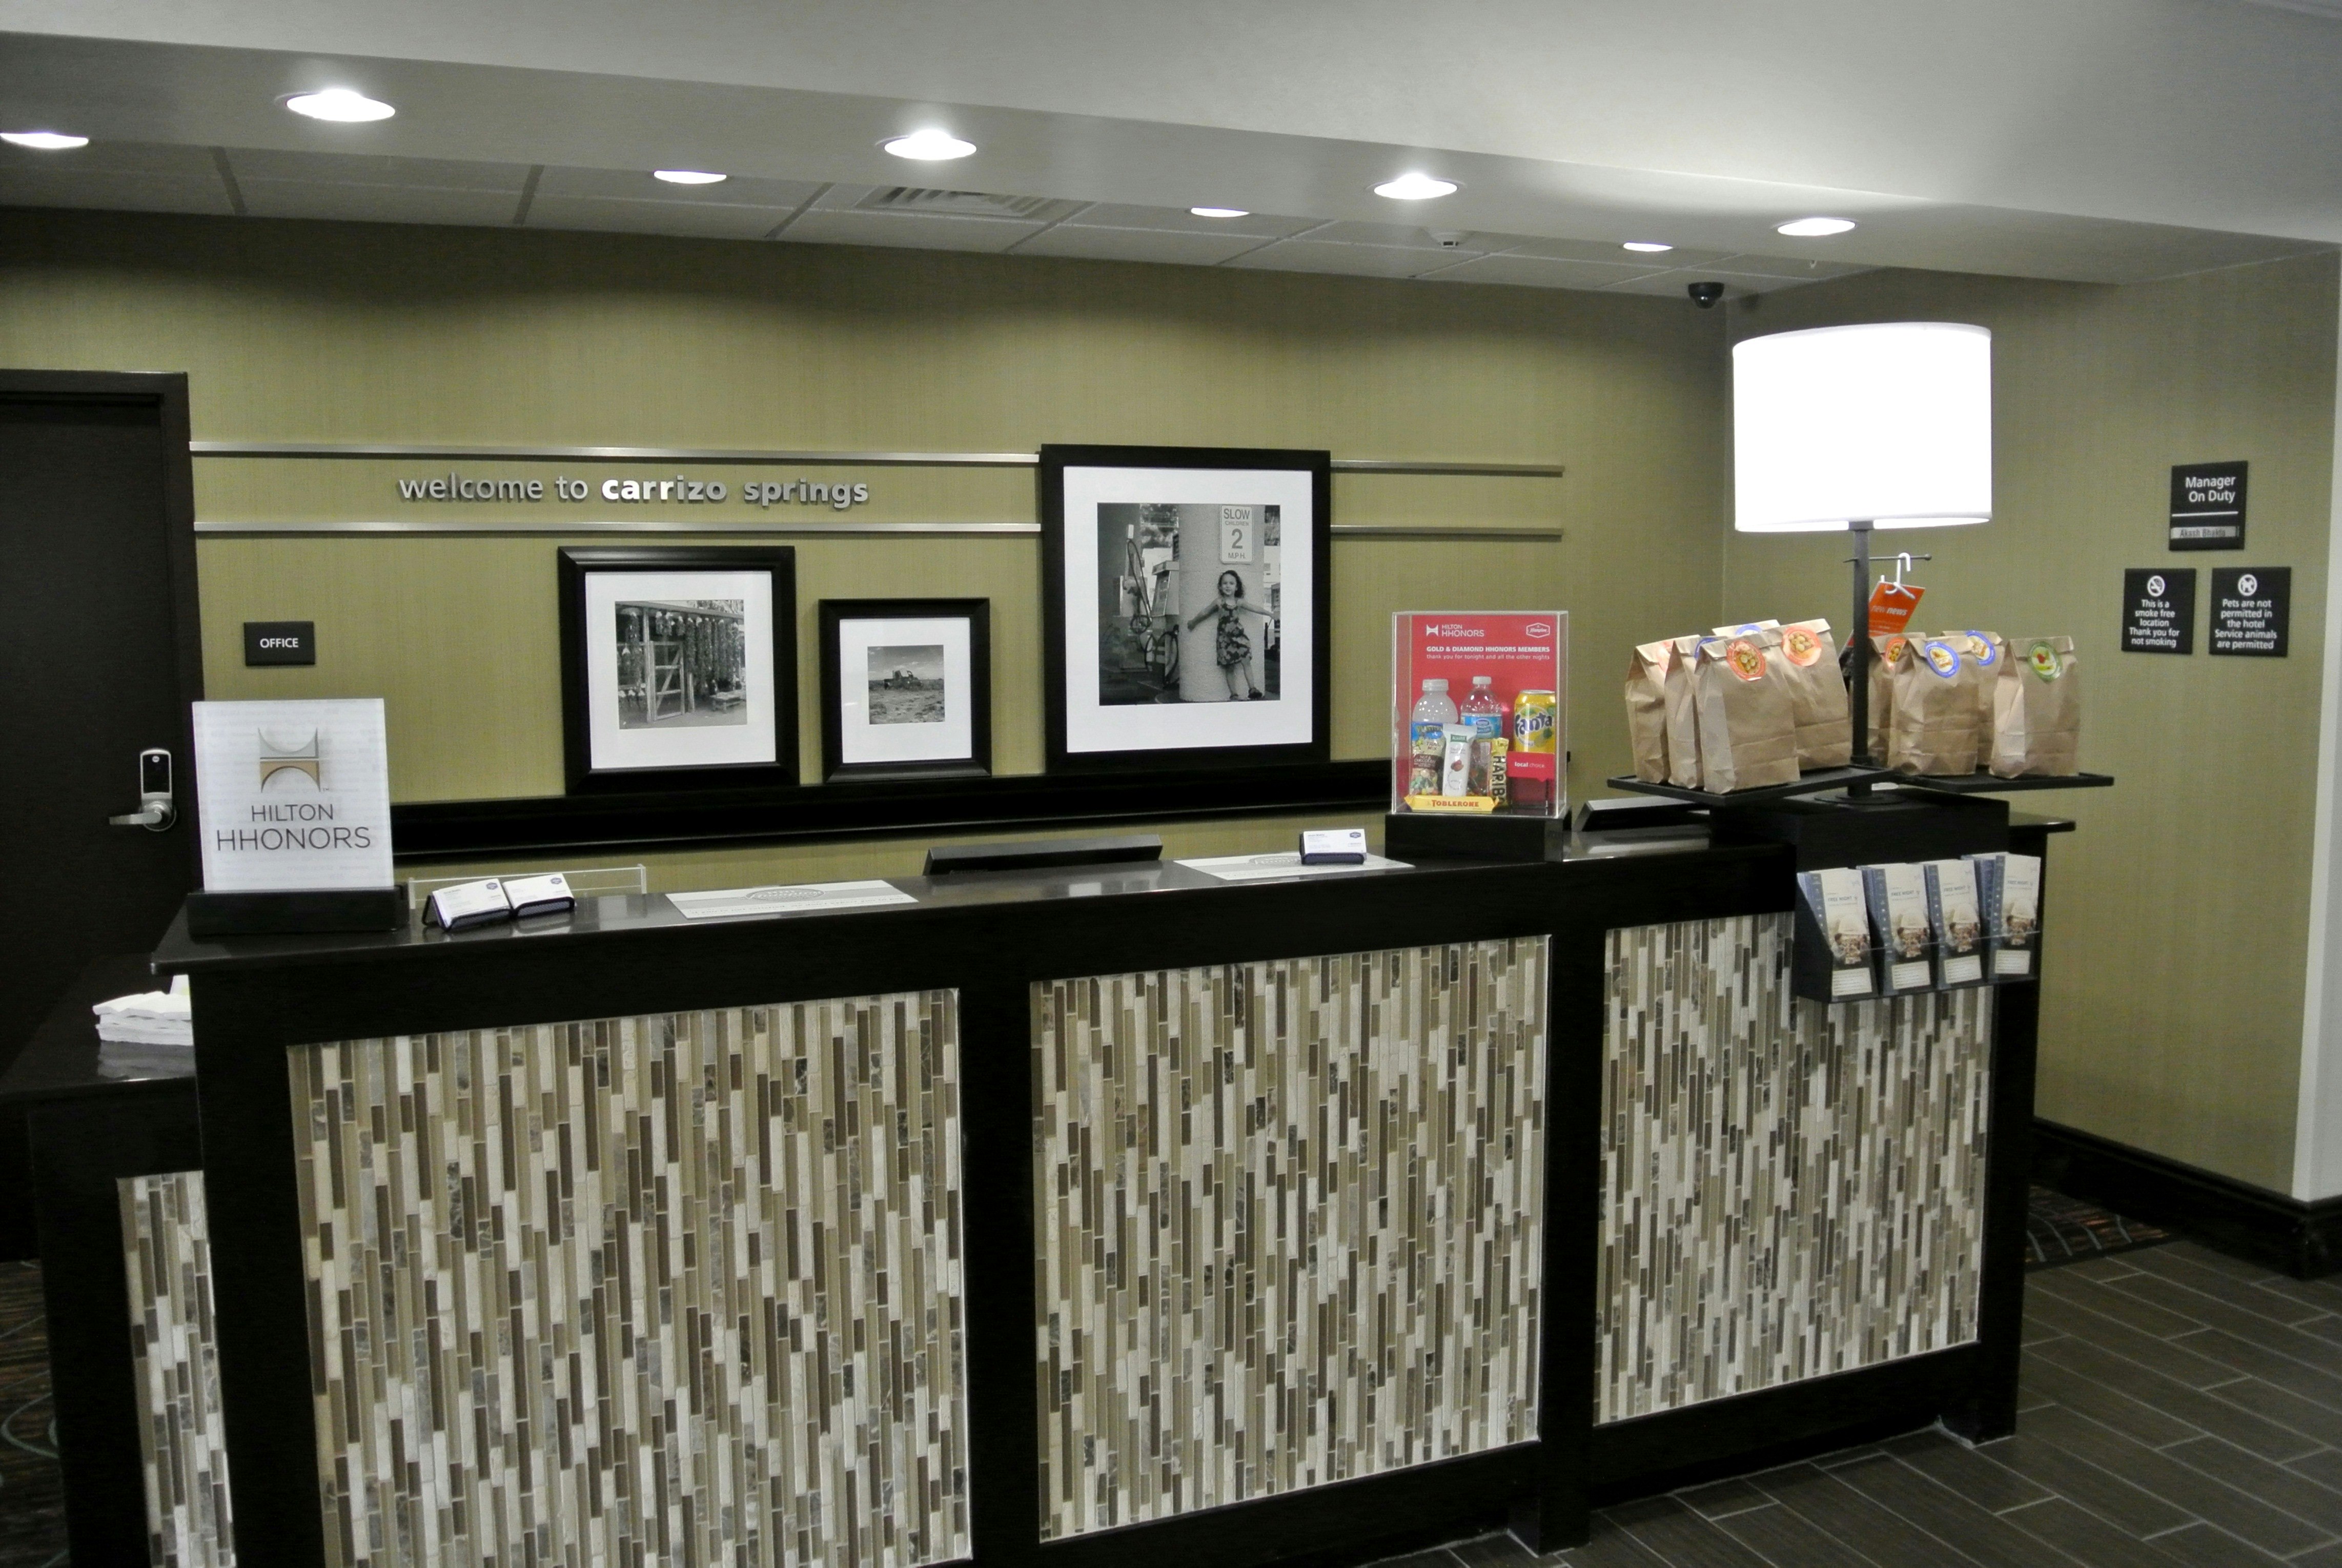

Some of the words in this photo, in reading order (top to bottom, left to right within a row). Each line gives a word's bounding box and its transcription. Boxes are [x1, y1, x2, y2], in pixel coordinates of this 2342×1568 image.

[2185, 477, 2236, 490] Manager
[399, 472, 543, 499] welcome
[556, 475, 588, 499] to
[601, 475, 727, 500] carrizo
[744, 477, 869, 508] springs
[2189, 491, 2206, 502] On
[2209, 490, 2236, 504] Duty
[1224, 508, 1250, 520] SLOW
[1231, 528, 1243, 549] 2
[2142, 599, 2156, 608] This
[2157, 599, 2163, 608] is
[2223, 598, 2239, 607] Pets
[2257, 600, 2272, 608] not
[2135, 609, 2158, 617] smoke
[2160, 609, 2175, 618] free
[2221, 609, 2263, 620] permitted
[2264, 609, 2273, 618] in
[2140, 618, 2169, 626] location
[2227, 619, 2241, 628] the
[2243, 619, 2265, 628] hotel
[2129, 627, 2152, 635] Thank
[2153, 630, 2167, 638] you
[2168, 628, 2180, 637] for
[2215, 628, 2244, 638] Service
[2245, 629, 2277, 639] animals
[259, 637, 299, 649] OFFICE
[2145, 638, 2177, 648] smoking
[2232, 640, 2274, 650] permitted
[1431, 799, 1479, 807] TOBLERONE
[251, 803, 334, 822] HILTON
[216, 826, 371, 851] HHONORS
